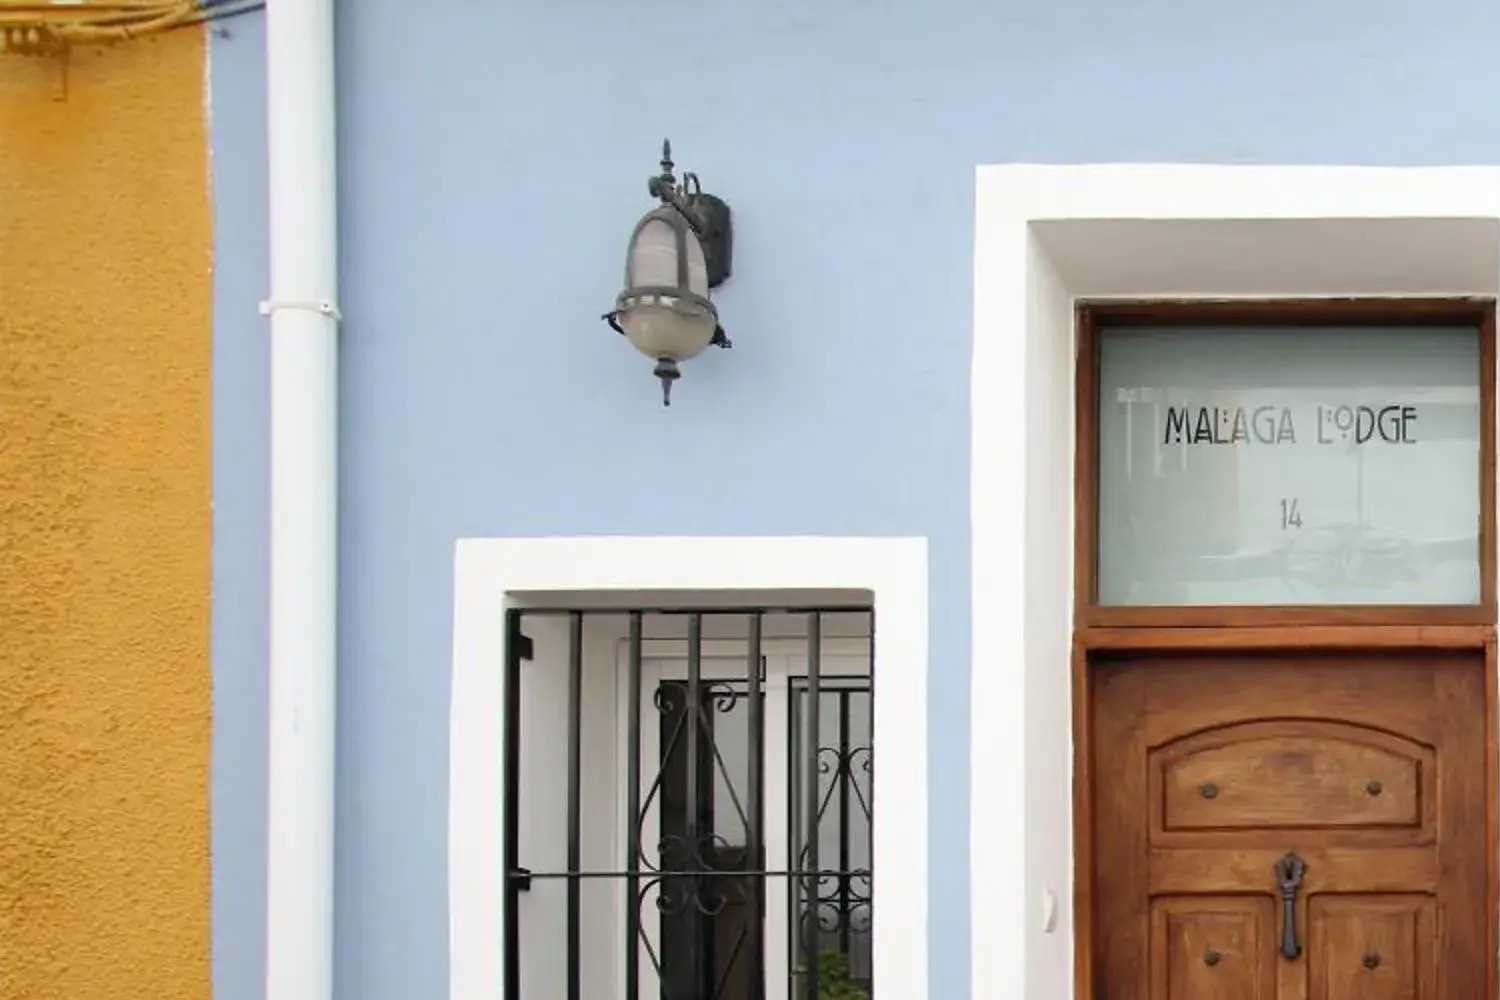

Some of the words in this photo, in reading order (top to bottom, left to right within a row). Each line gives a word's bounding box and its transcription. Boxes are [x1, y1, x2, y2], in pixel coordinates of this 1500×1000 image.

[1164, 406, 1295, 444] MALAGA
[1318, 405, 1416, 444] LODGE
[1280, 498, 1303, 530] 14
